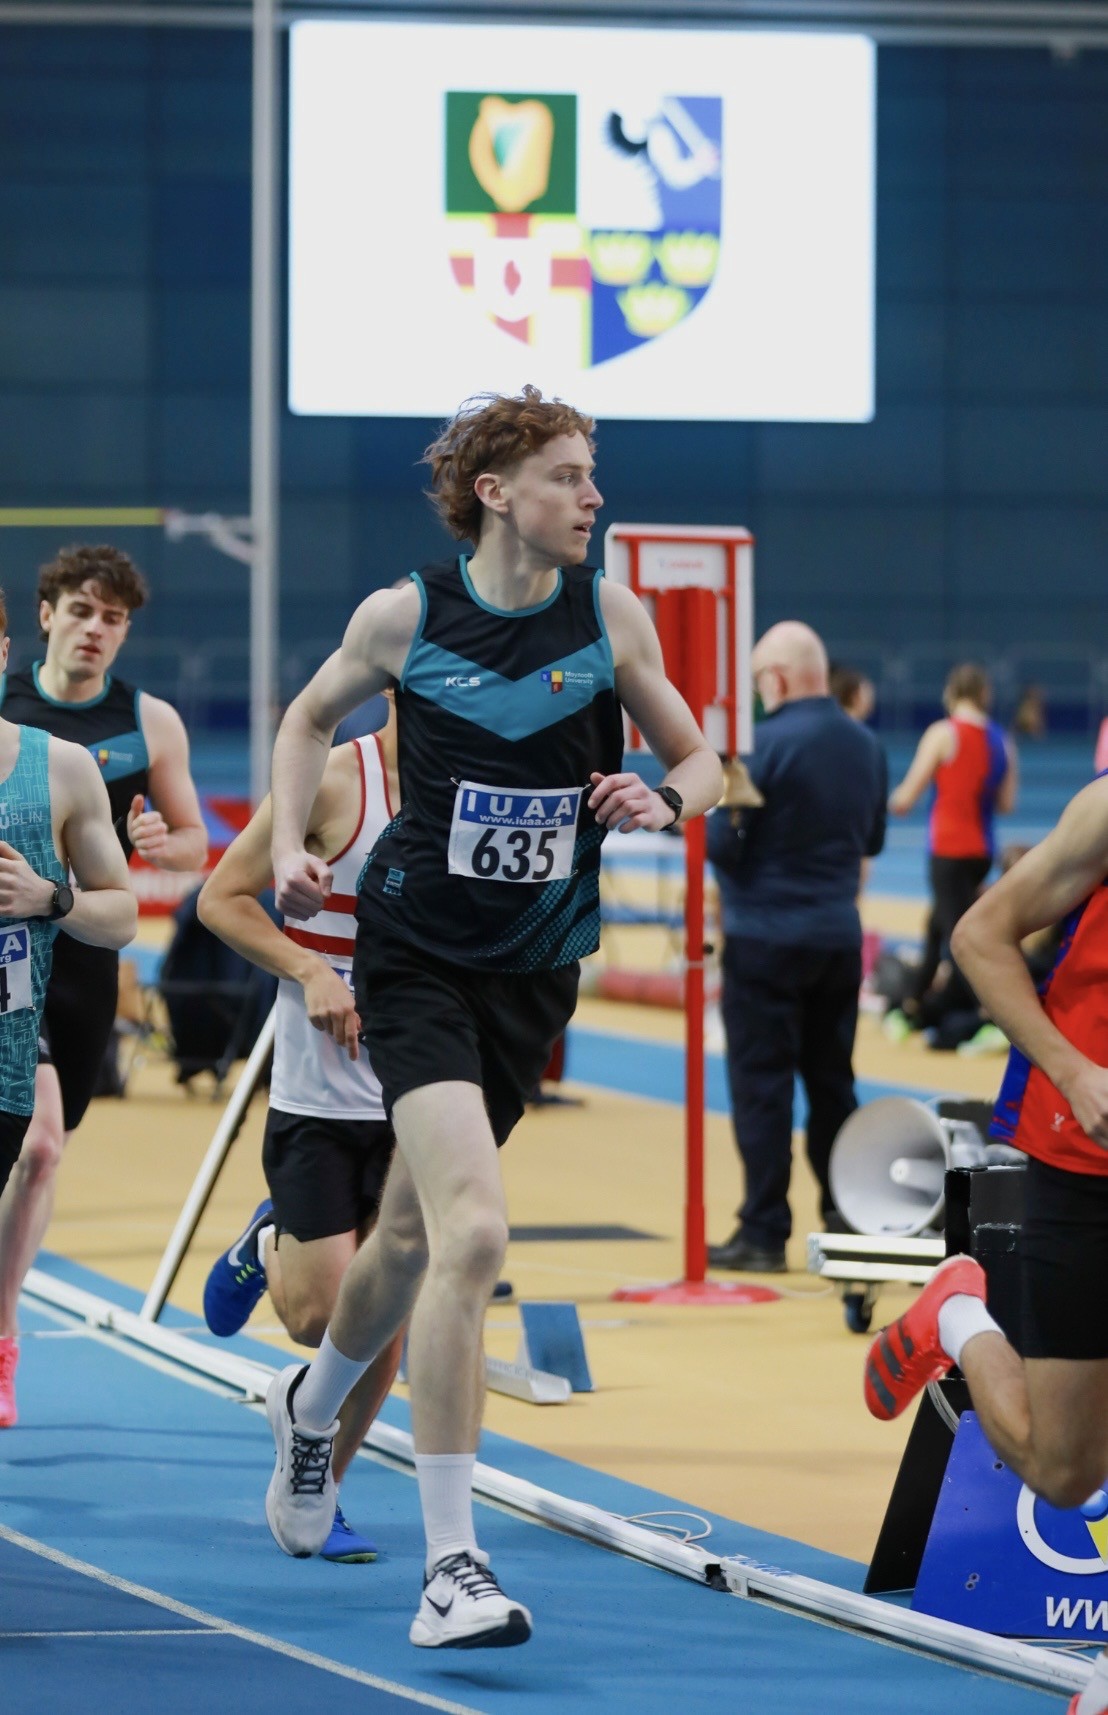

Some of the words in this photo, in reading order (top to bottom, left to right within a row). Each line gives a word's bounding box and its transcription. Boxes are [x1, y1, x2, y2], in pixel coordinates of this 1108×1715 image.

[565, 671, 594, 679] Maynooth
[445, 676, 481, 687] KCS
[565, 677, 594, 685] University
[479, 814, 562, 826] www.iuaa.org
[471, 828, 558, 881] 635
